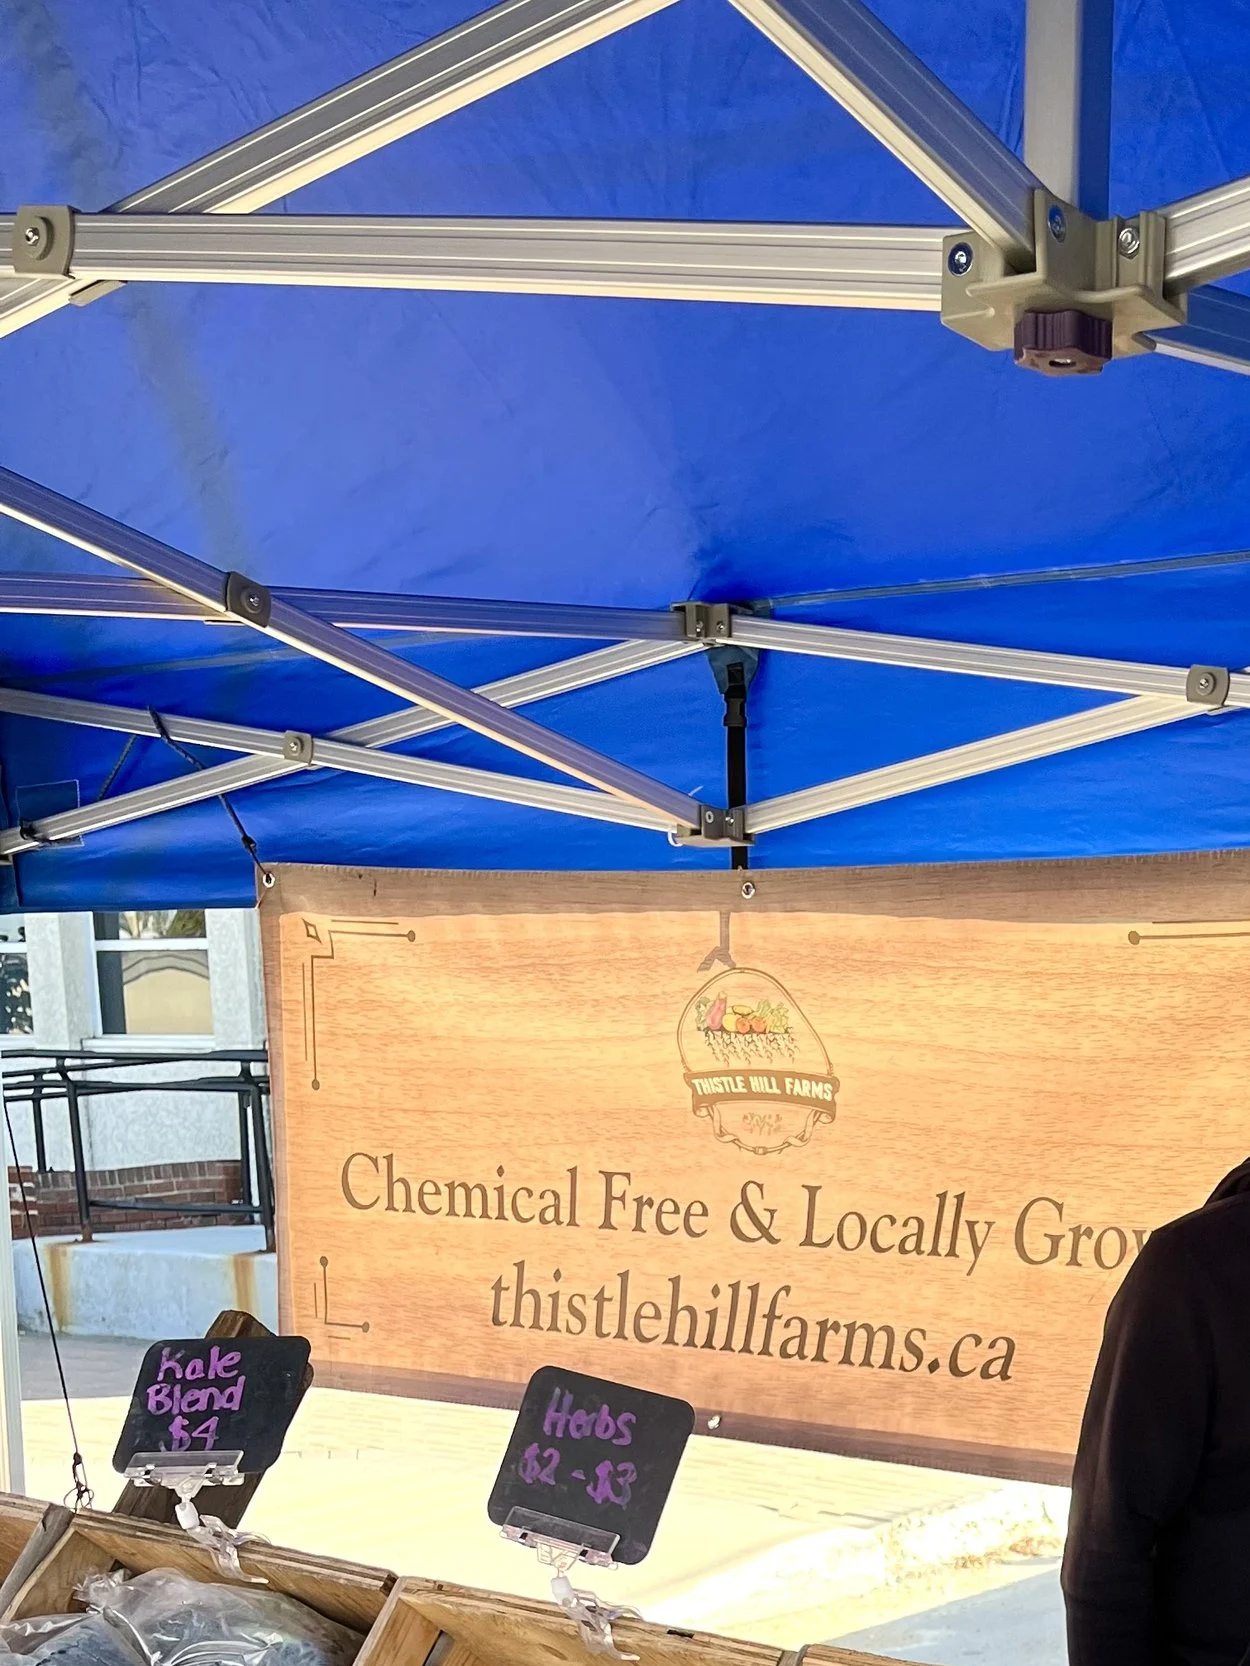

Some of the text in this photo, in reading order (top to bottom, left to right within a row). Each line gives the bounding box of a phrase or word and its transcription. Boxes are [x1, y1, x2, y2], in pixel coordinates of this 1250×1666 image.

[691, 1076, 834, 1102] THISTLE HILL FARMS
[341, 1151, 580, 1227] Chemical
[598, 1170, 710, 1239] Free
[729, 1180, 781, 1246] &
[799, 1184, 996, 1277] Locally
[491, 1259, 1017, 1382] thistlehillfarms.ca
[157, 1345, 242, 1382] Kale
[146, 1375, 247, 1416] Blend
[542, 1386, 637, 1446] Herbs
[158, 1415, 220, 1452] $4
[518, 1442, 557, 1486] $2
[586, 1459, 638, 1507] $3
